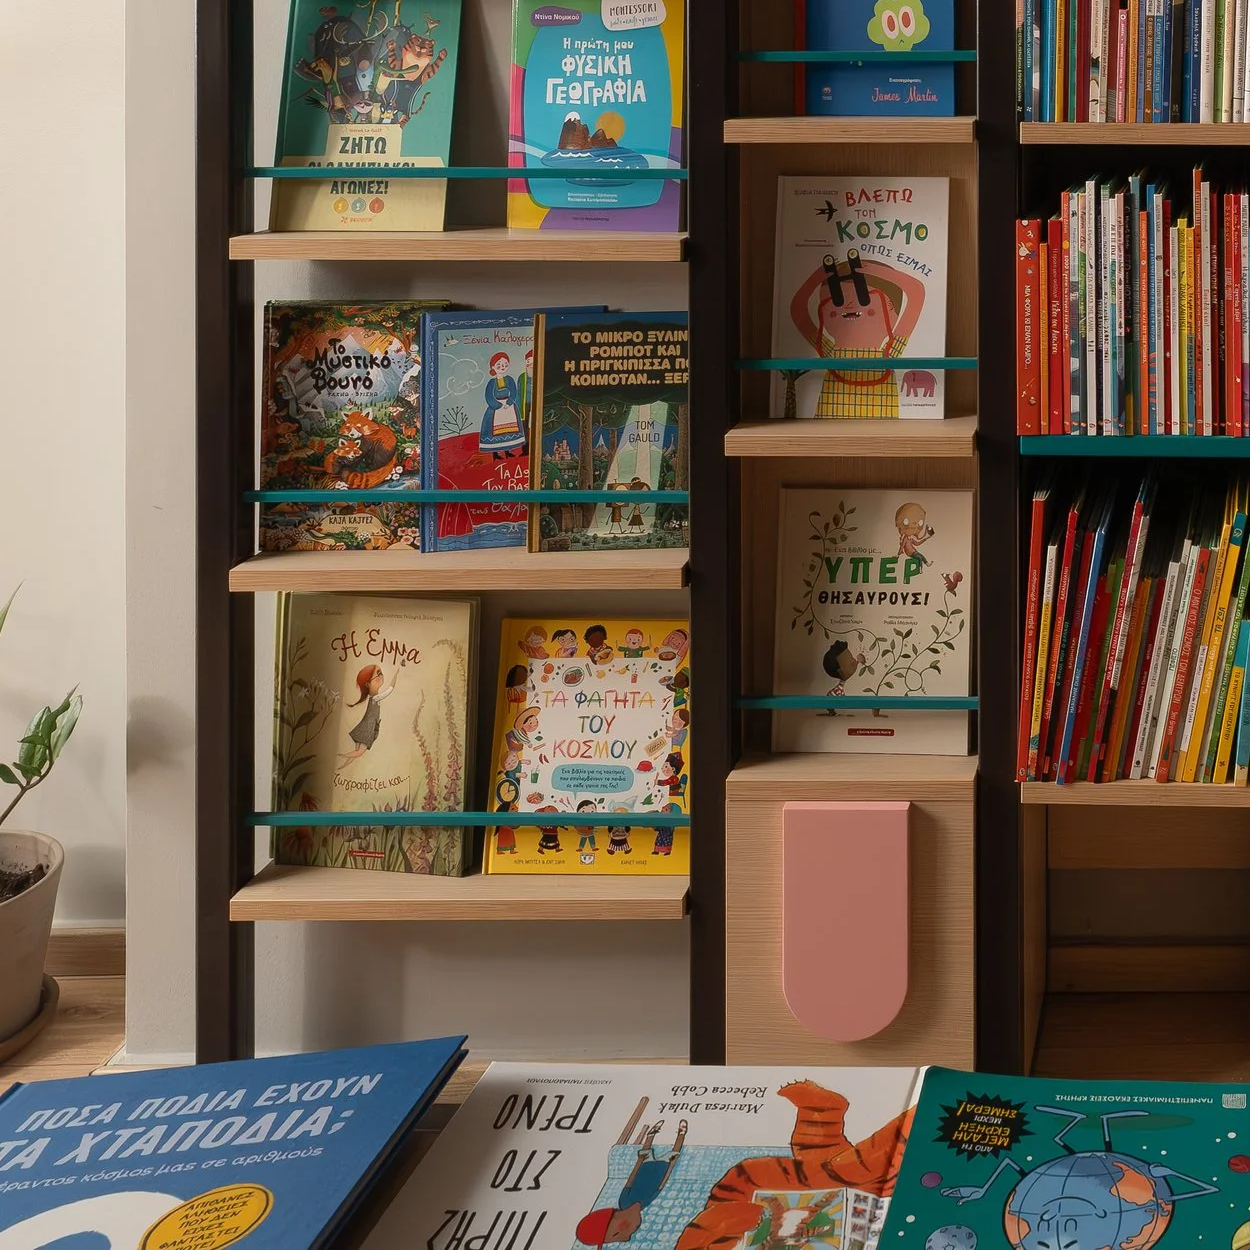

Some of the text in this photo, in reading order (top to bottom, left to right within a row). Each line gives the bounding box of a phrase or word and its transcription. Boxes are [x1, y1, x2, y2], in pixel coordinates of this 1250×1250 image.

[535, 13, 580, 22] Ντίνα Νομικού
[610, 4, 657, 17] MONTESSORI
[563, 38, 634, 54] Η πρώτη μου
[562, 54, 633, 77] ΦΥΣΙΚΗ
[546, 78, 647, 107] ΓΕΩΓΡΑΦΙΑ
[339, 136, 387, 154] ΖΗΤΩ
[330, 180, 389, 195] ΑΓΩΝΕΣ!
[846, 188, 913, 207] ΒΛΕΠΩ
[836, 218, 929, 245] ΚΟΣΜΟ
[860, 244, 933, 278] ΟΠΩΣ ΕΙΜΑΙ
[328, 338, 346, 355] Το
[572, 330, 688, 344] ΤΟ ΜΙΚΡΟ ΞΥΛΙΝ
[306, 348, 392, 372] Μυστικό
[590, 344, 681, 359] ΡΟΜΠΟΤ ΚΑΙ
[311, 367, 374, 394] Βουνό
[635, 421, 656, 430] TOM
[629, 431, 661, 443] GAULD
[824, 556, 921, 585] ΥΠΕΡ
[818, 591, 930, 606] ΘΗΣΑΥΡΟΥΣ!
[1214, 607, 1226, 634] ΤΑ ΖΩΑ
[331, 628, 422, 666] Η Έμμα
[542, 690, 656, 710] ΤΑ ΦΑΓΗΤΑ
[578, 715, 616, 735] ΤΟΥ
[553, 740, 637, 760] ΚΟΣΜΟΥ
[672, 1085, 767, 1099] Rebecca Cobb
[15, 1073, 383, 1133] ΠΟΣΑ ΠΟΔΙΑ ΕΧΟΥΝ
[658, 1102, 764, 1115] Mariesa Dulak
[956, 1102, 1018, 1124] ΣΗΜΕΡΑ!
[493, 1094, 605, 1134] ΤΡΕΝΟ
[974, 1116, 1002, 1125] ΜΕΧΡΙ
[952, 1131, 1010, 1146] ΜΕΓΑΛΗ
[959, 1122, 1011, 1136] ΕΚΡΗΞΗ
[0, 1108, 355, 1171] ΤΑ ΧΤΑΠΟΔΙΑ;
[961, 1144, 993, 1153] ΑΠΟ ΤΗ
[81, 1164, 152, 1184] κόσμος
[155, 1160, 196, 1177] μας
[202, 1157, 226, 1170] σε
[232, 1146, 324, 1167] αριθμούς
[490, 1150, 562, 1192] ΣΤΟ
[179, 1201, 249, 1221] ΑΛΗΘΕΙΕΣ
[184, 1191, 256, 1212] ΑΠΙΘΑΝΕΣ
[178, 1210, 242, 1229] ΠΟΥ ΔΕΝ
[182, 1222, 225, 1237] ΕΙΧΕΣ
[159, 1227, 240, 1250] ΦΑΝΤΑΣΤΕΙ
